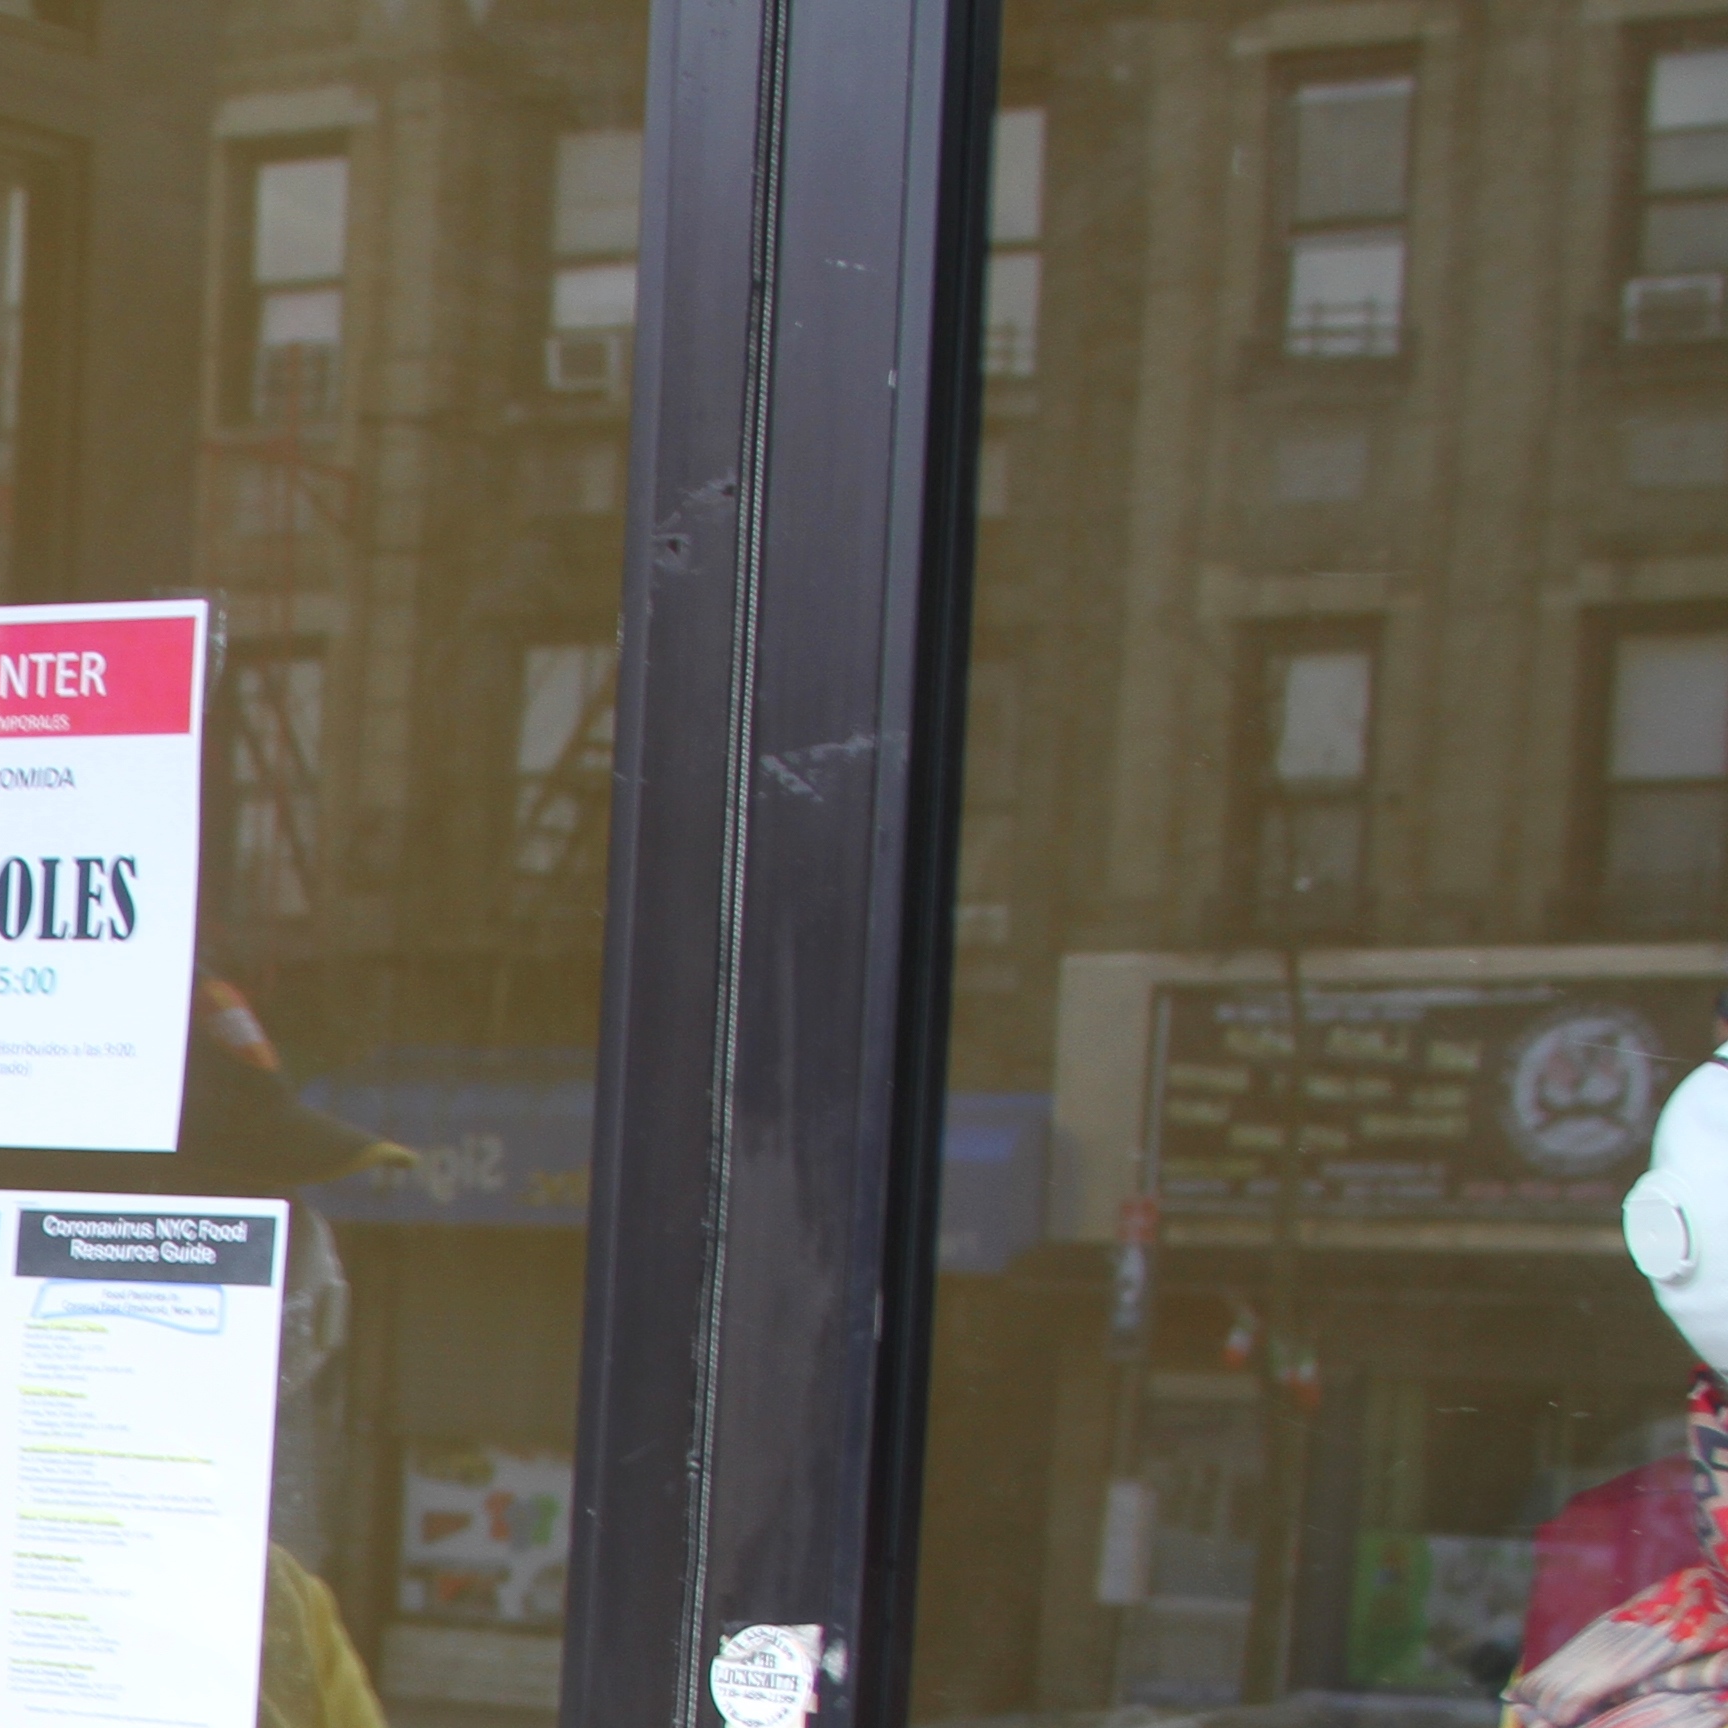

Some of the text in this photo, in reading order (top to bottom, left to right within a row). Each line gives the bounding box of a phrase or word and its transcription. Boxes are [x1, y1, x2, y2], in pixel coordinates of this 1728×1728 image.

[43, 1214, 248, 1242] Coronavirus NYC Food
[70, 1238, 216, 1264] Resource Guide
